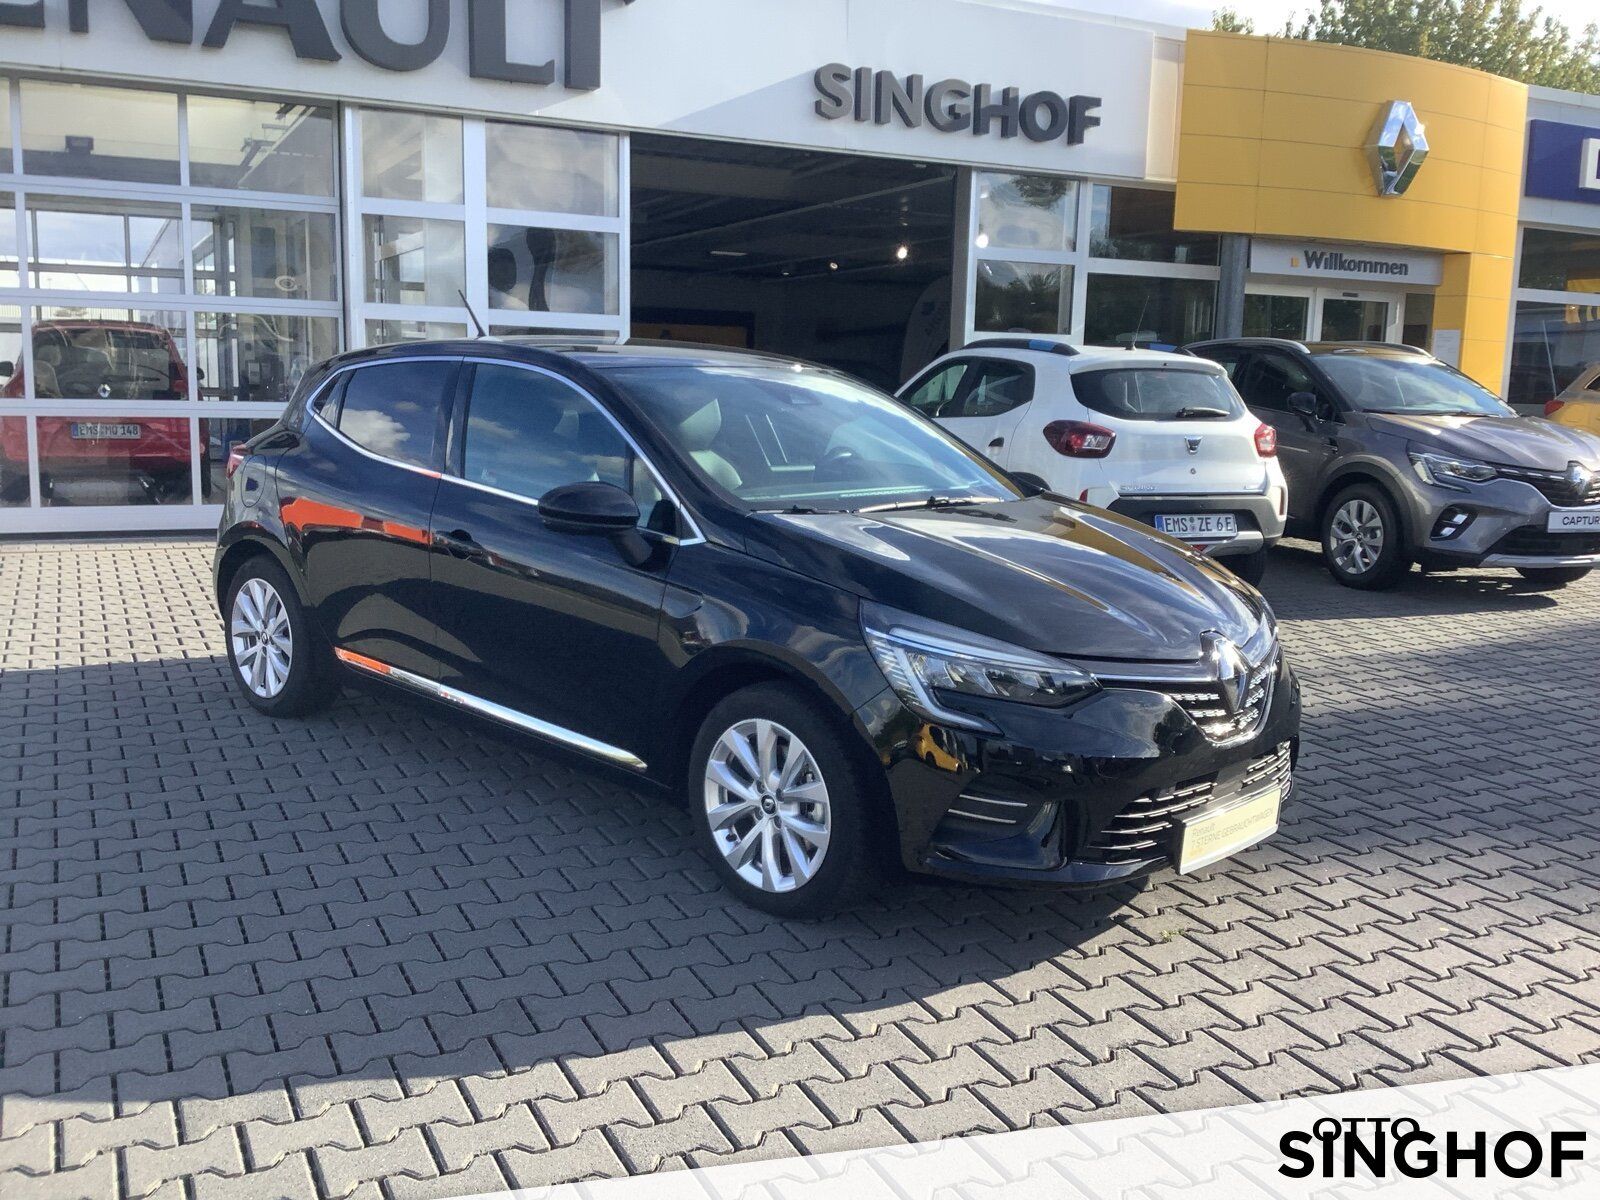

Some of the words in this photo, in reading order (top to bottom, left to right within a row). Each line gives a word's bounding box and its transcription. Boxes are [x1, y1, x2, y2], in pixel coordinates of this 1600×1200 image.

[814, 62, 1103, 146] SINGHOF
[1304, 249, 1409, 276] Willkommen
[120, 425, 138, 436] 148
[1164, 516, 1188, 533] EMS
[1197, 517, 1212, 532] ZE
[1562, 516, 1600, 526] CAPTUR
